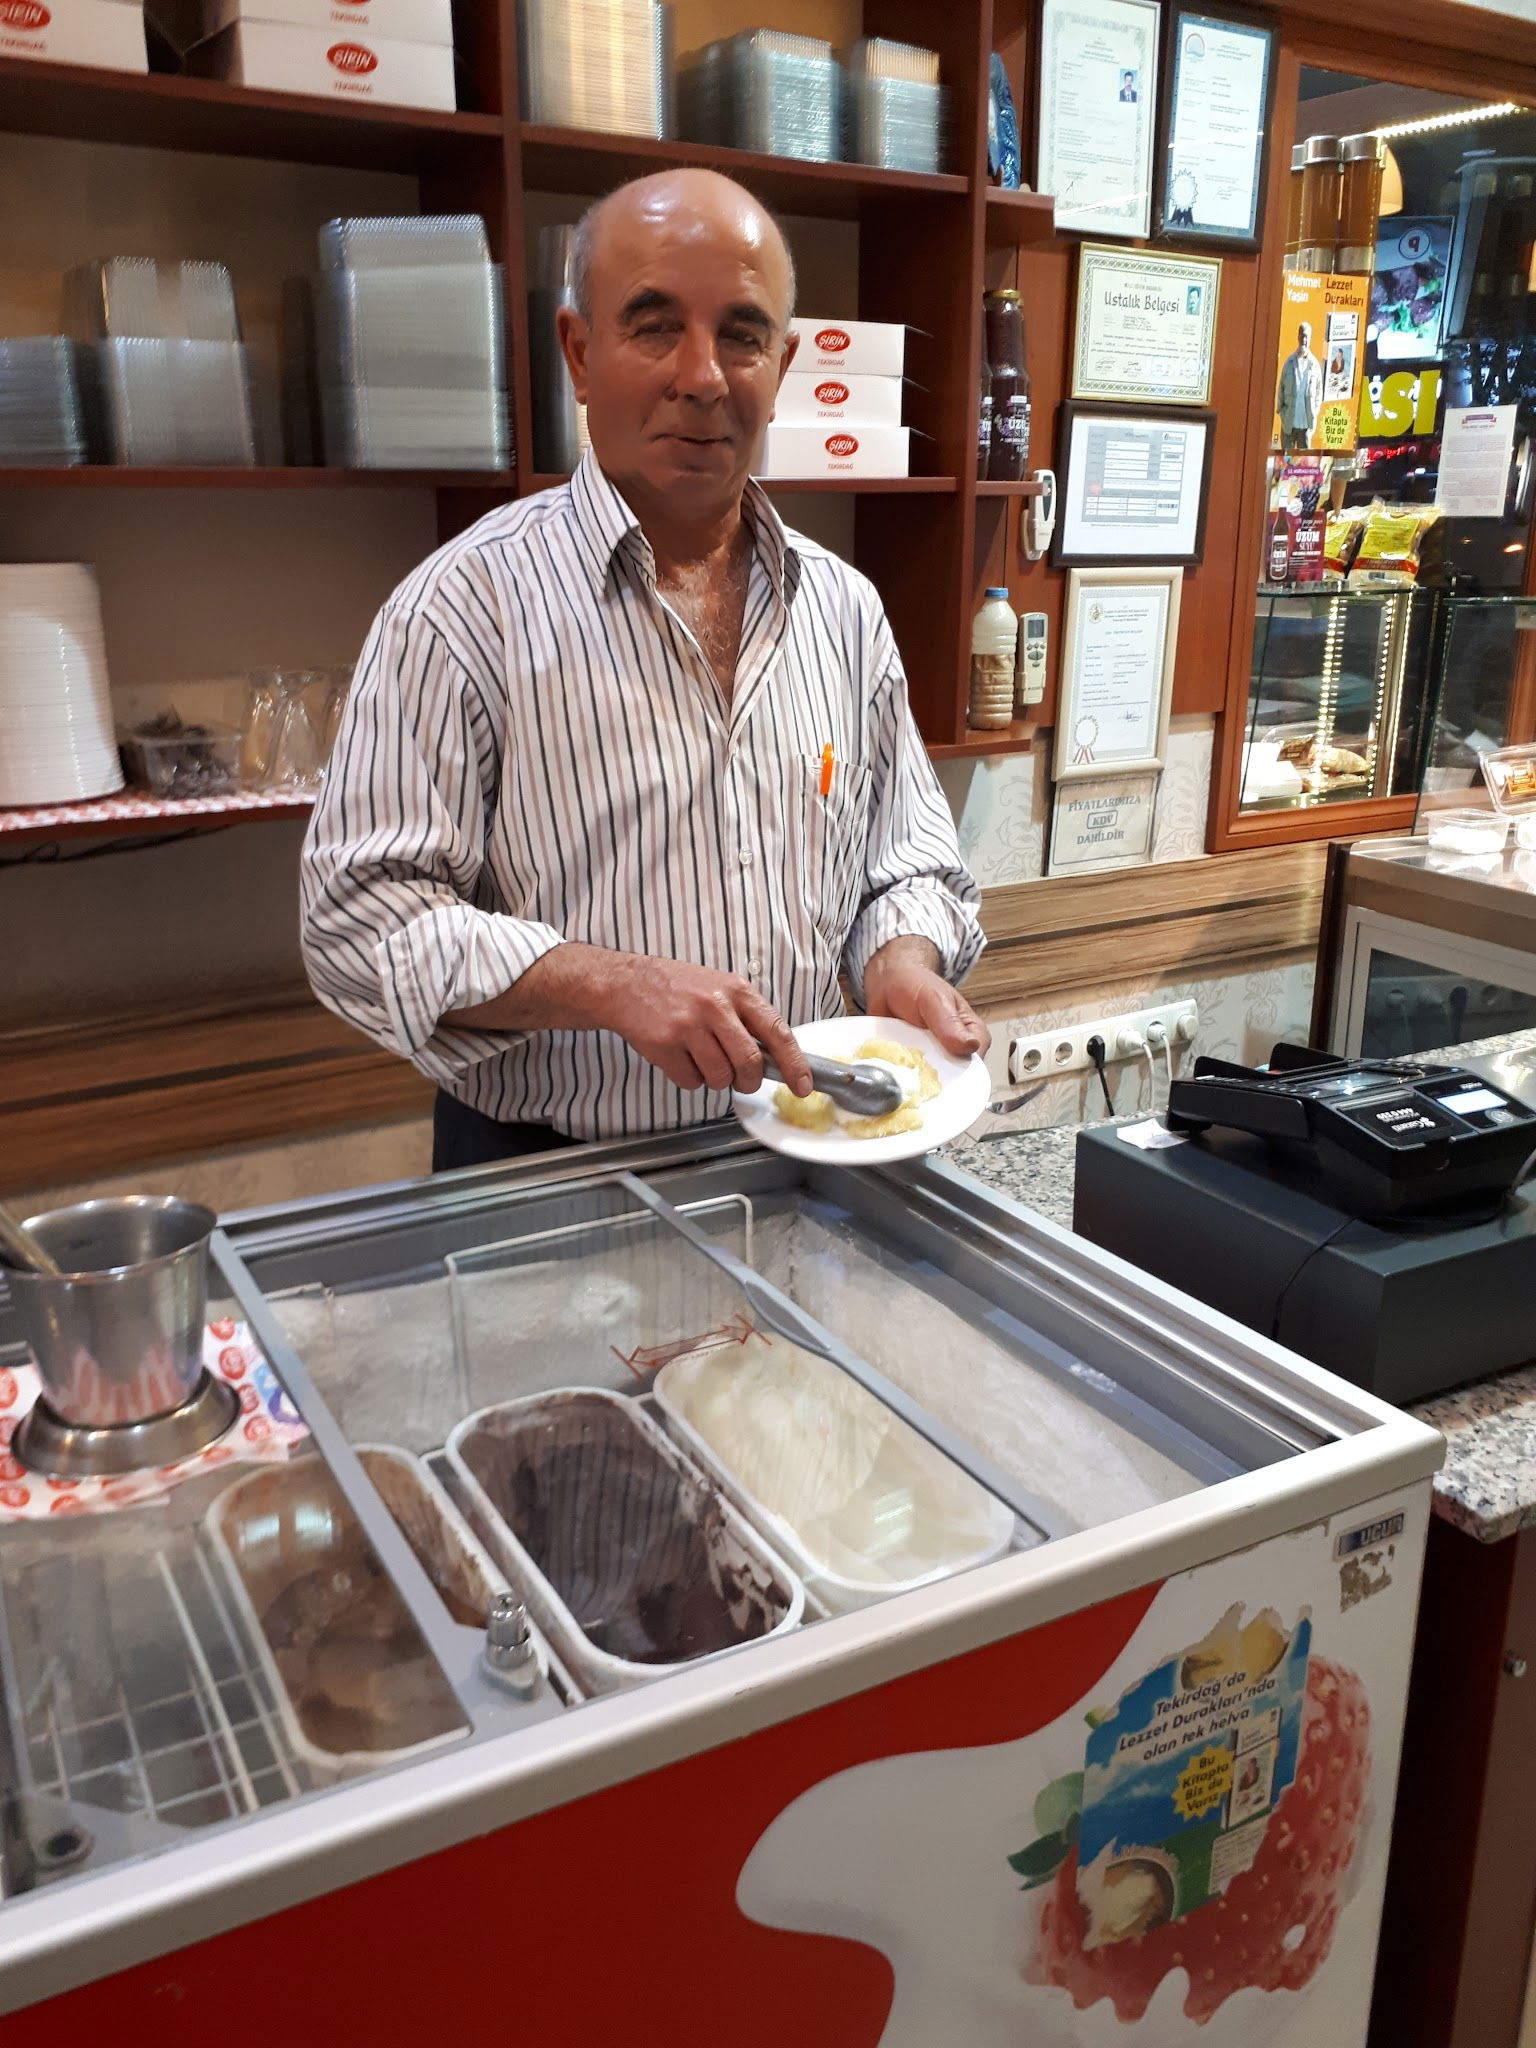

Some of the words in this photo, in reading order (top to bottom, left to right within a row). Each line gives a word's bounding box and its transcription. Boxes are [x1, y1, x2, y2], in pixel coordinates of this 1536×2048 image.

[1288, 274, 1320, 288] Mehmet
[1326, 278, 1353, 290] Lezzet
[1104, 291, 1140, 309] Ustalık
[1144, 295, 1180, 316] Belgesi
[1324, 293, 1364, 307] Durakları
[1332, 407, 1342, 417] Bu
[1324, 417, 1348, 427] Kitapta
[1325, 426, 1336, 434] Biz
[1336, 426, 1345, 435] de
[1092, 814, 1113, 826] KDV
[1077, 829, 1124, 844] DAHİLDİR
[1119, 1721, 1168, 1752] Lezzet
[1143, 1739, 1177, 1761] olan
[1182, 1725, 1204, 1745] tek
[1209, 1709, 1250, 1733] helva
[1200, 1756, 1215, 1769] Bu
[1182, 1763, 1229, 1789] Kitapta
[1185, 1787, 1203, 1801] Biz
[1208, 1778, 1223, 1790] de
